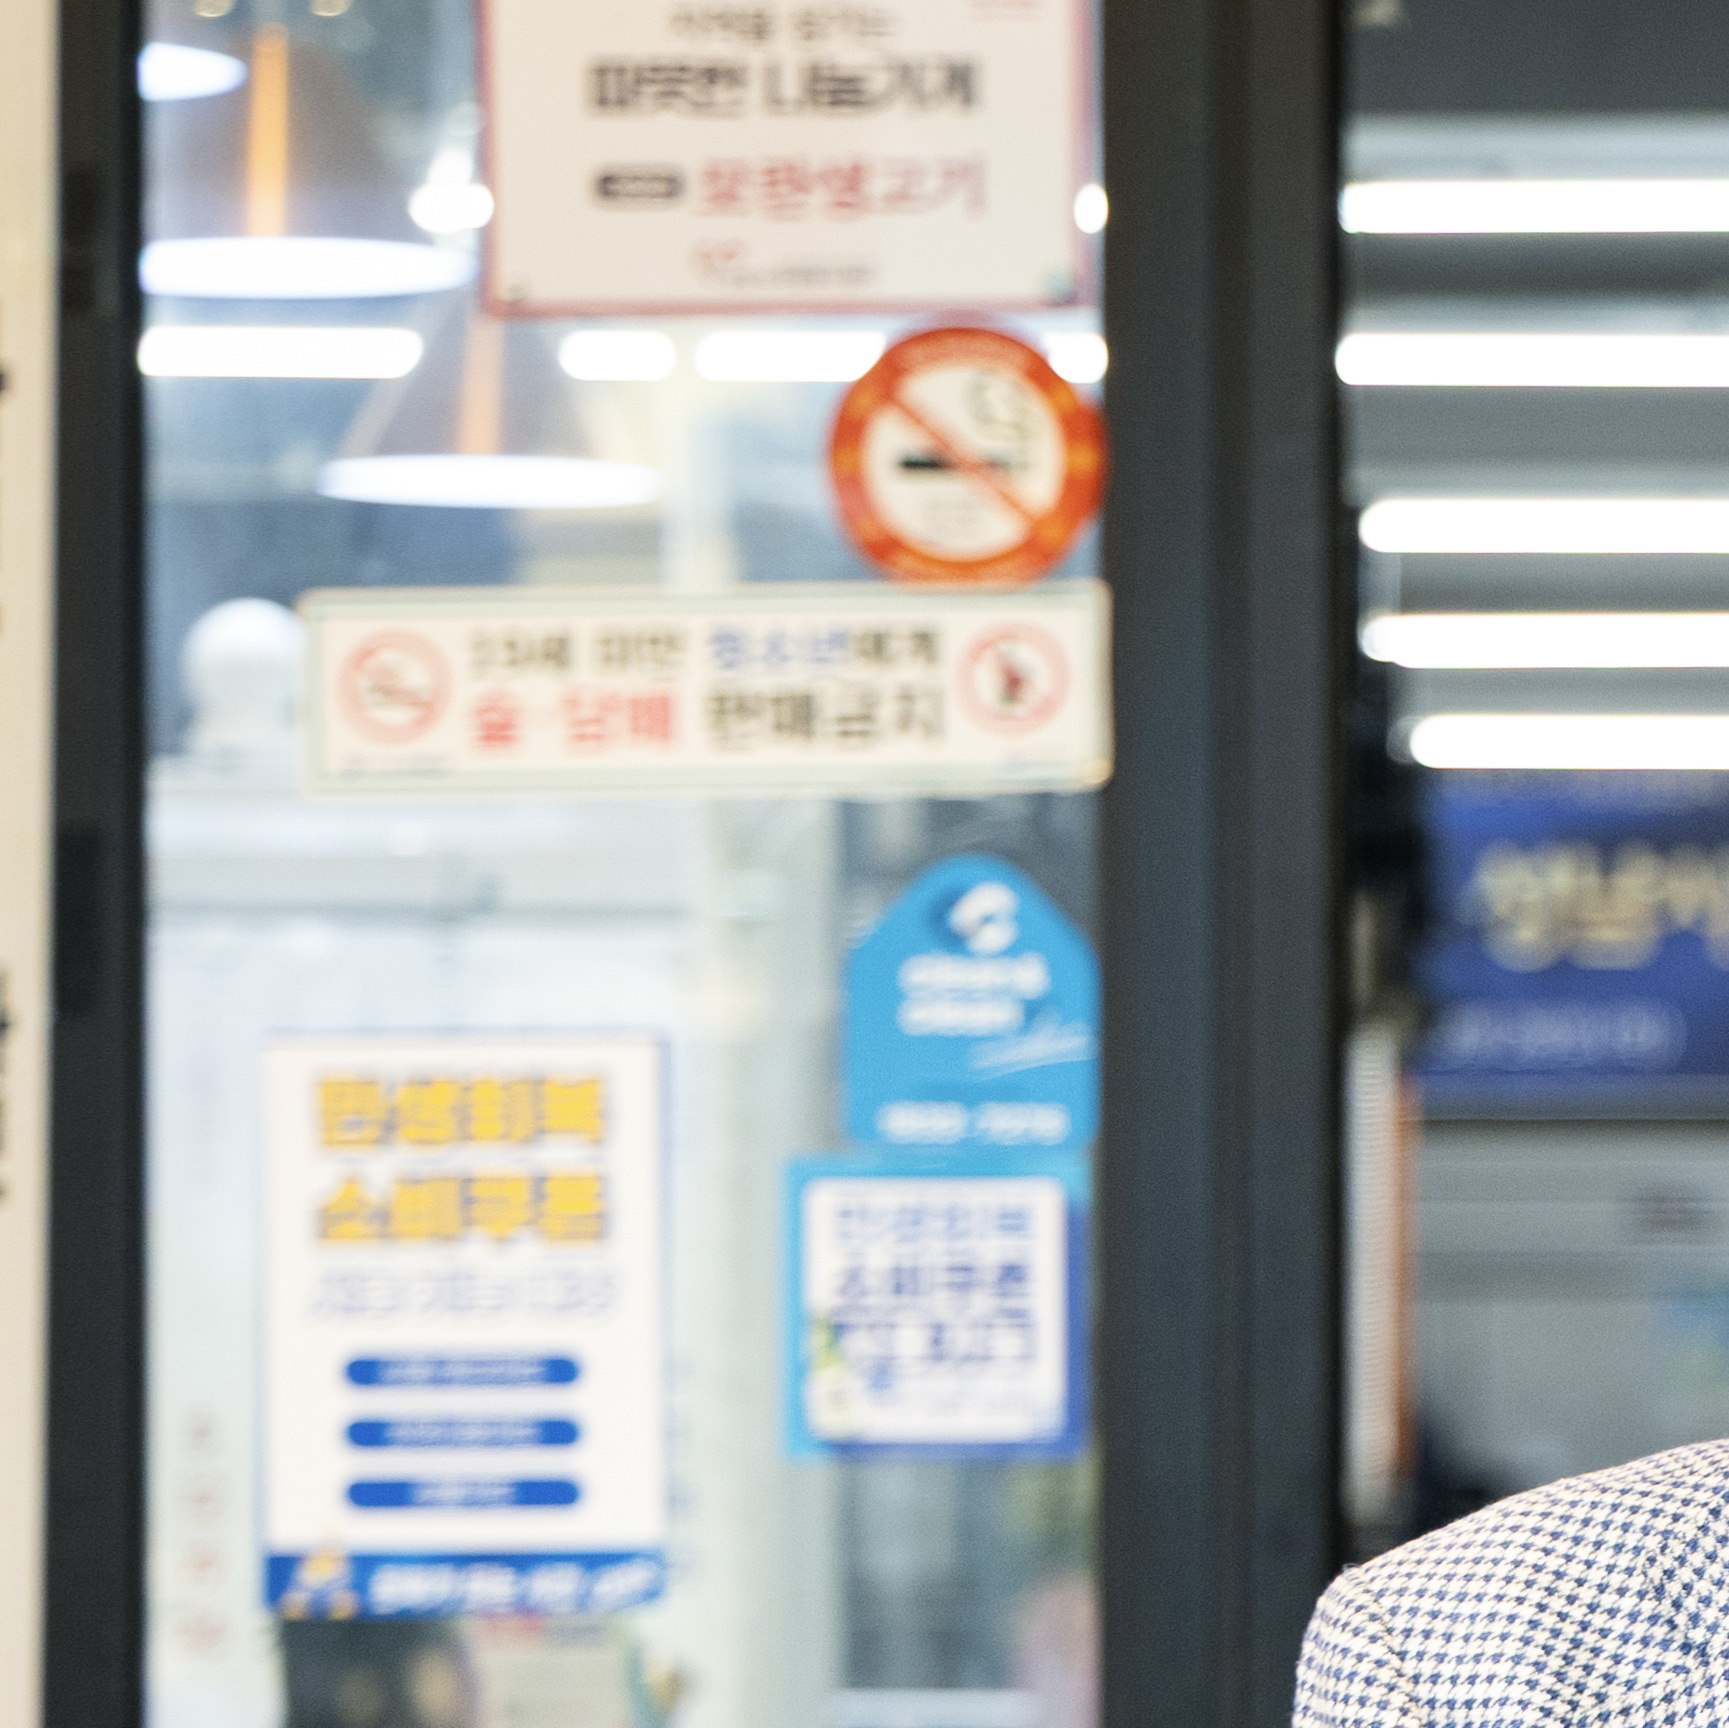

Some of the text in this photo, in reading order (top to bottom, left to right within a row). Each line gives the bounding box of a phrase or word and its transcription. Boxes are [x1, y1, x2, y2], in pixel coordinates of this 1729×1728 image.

[586, 58, 984, 118] 따뜻한 나눔가게
[596, 622, 688, 676] 미만
[703, 685, 948, 748] 판매금지
[315, 1072, 609, 1151] 민생회복
[315, 1170, 609, 1247] 소비쿠폰
